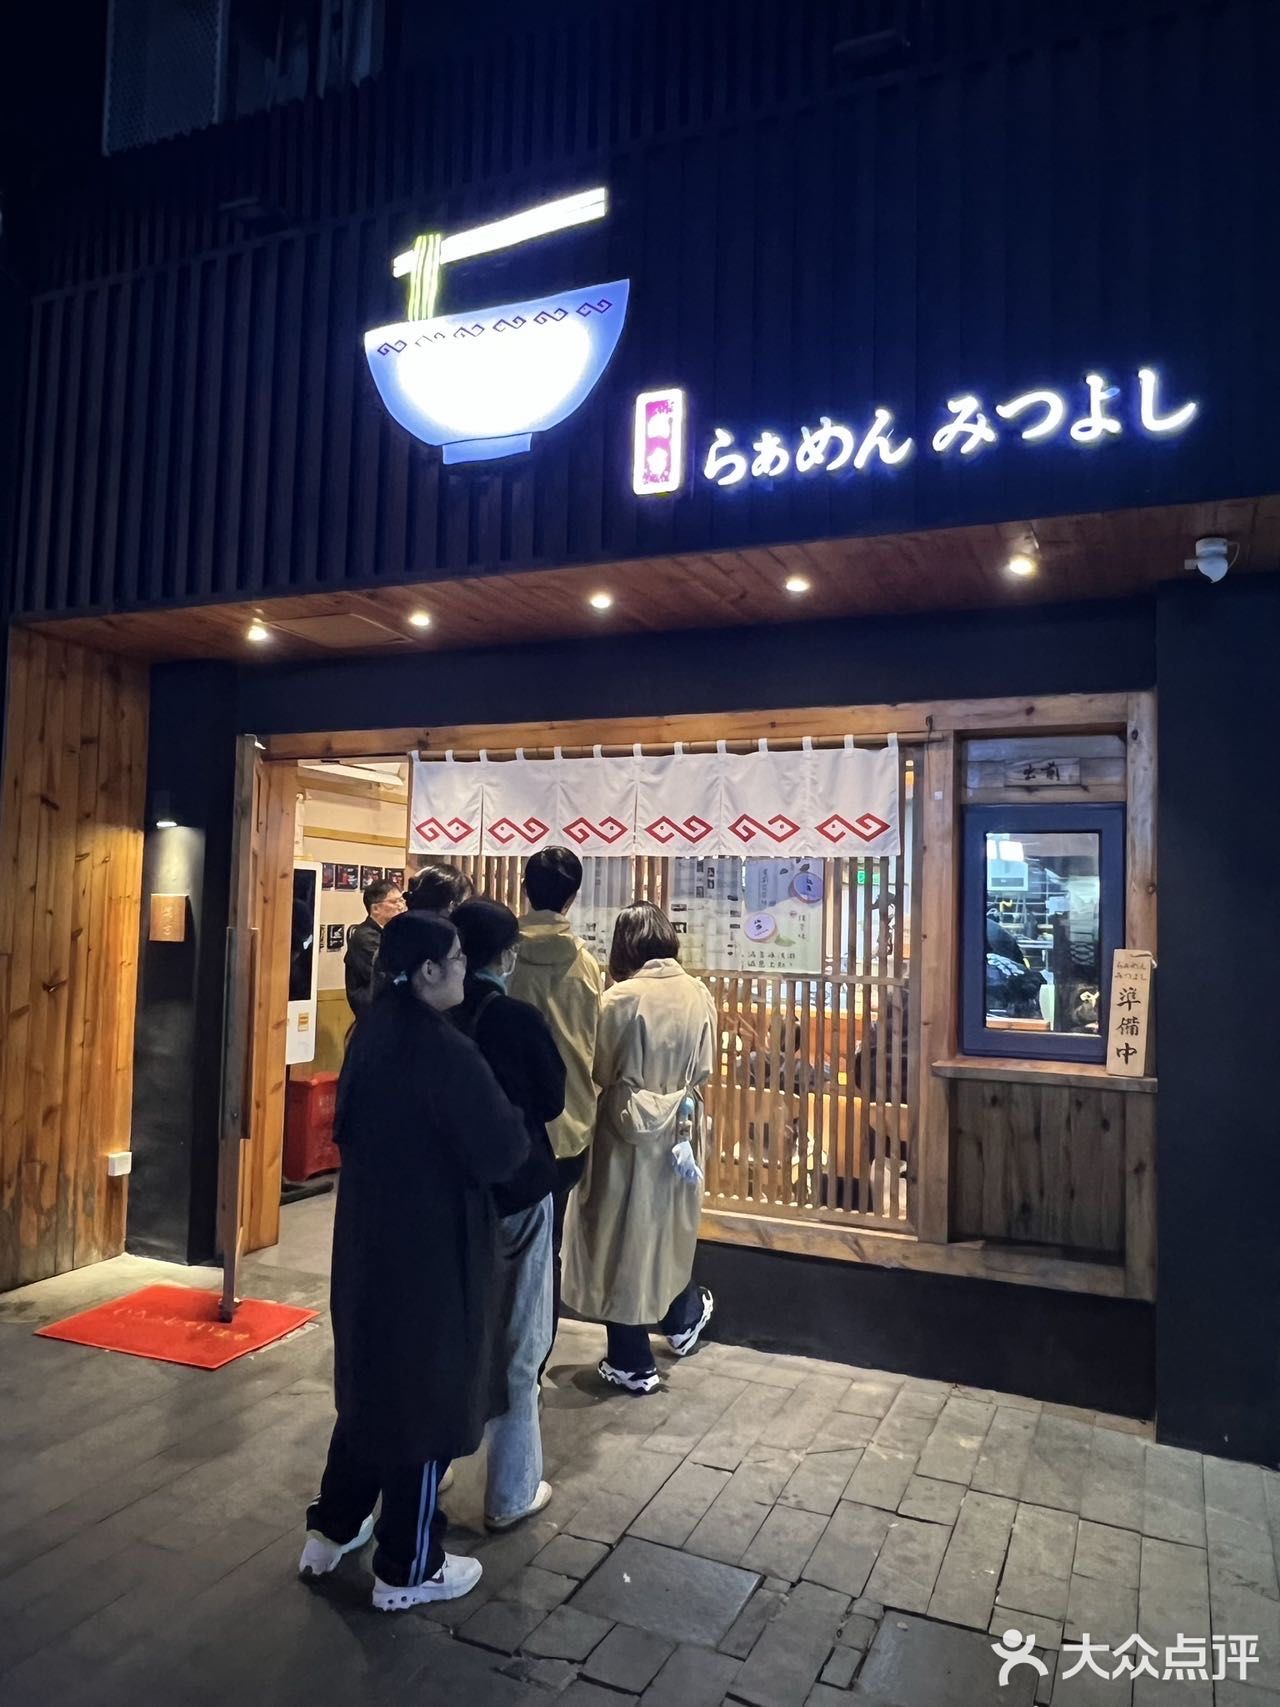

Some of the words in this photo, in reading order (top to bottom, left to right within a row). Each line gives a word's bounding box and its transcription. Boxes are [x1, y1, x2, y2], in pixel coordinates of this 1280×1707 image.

[931, 369, 1197, 455] みつよし
[1116, 987, 1142, 1065] 準備中
